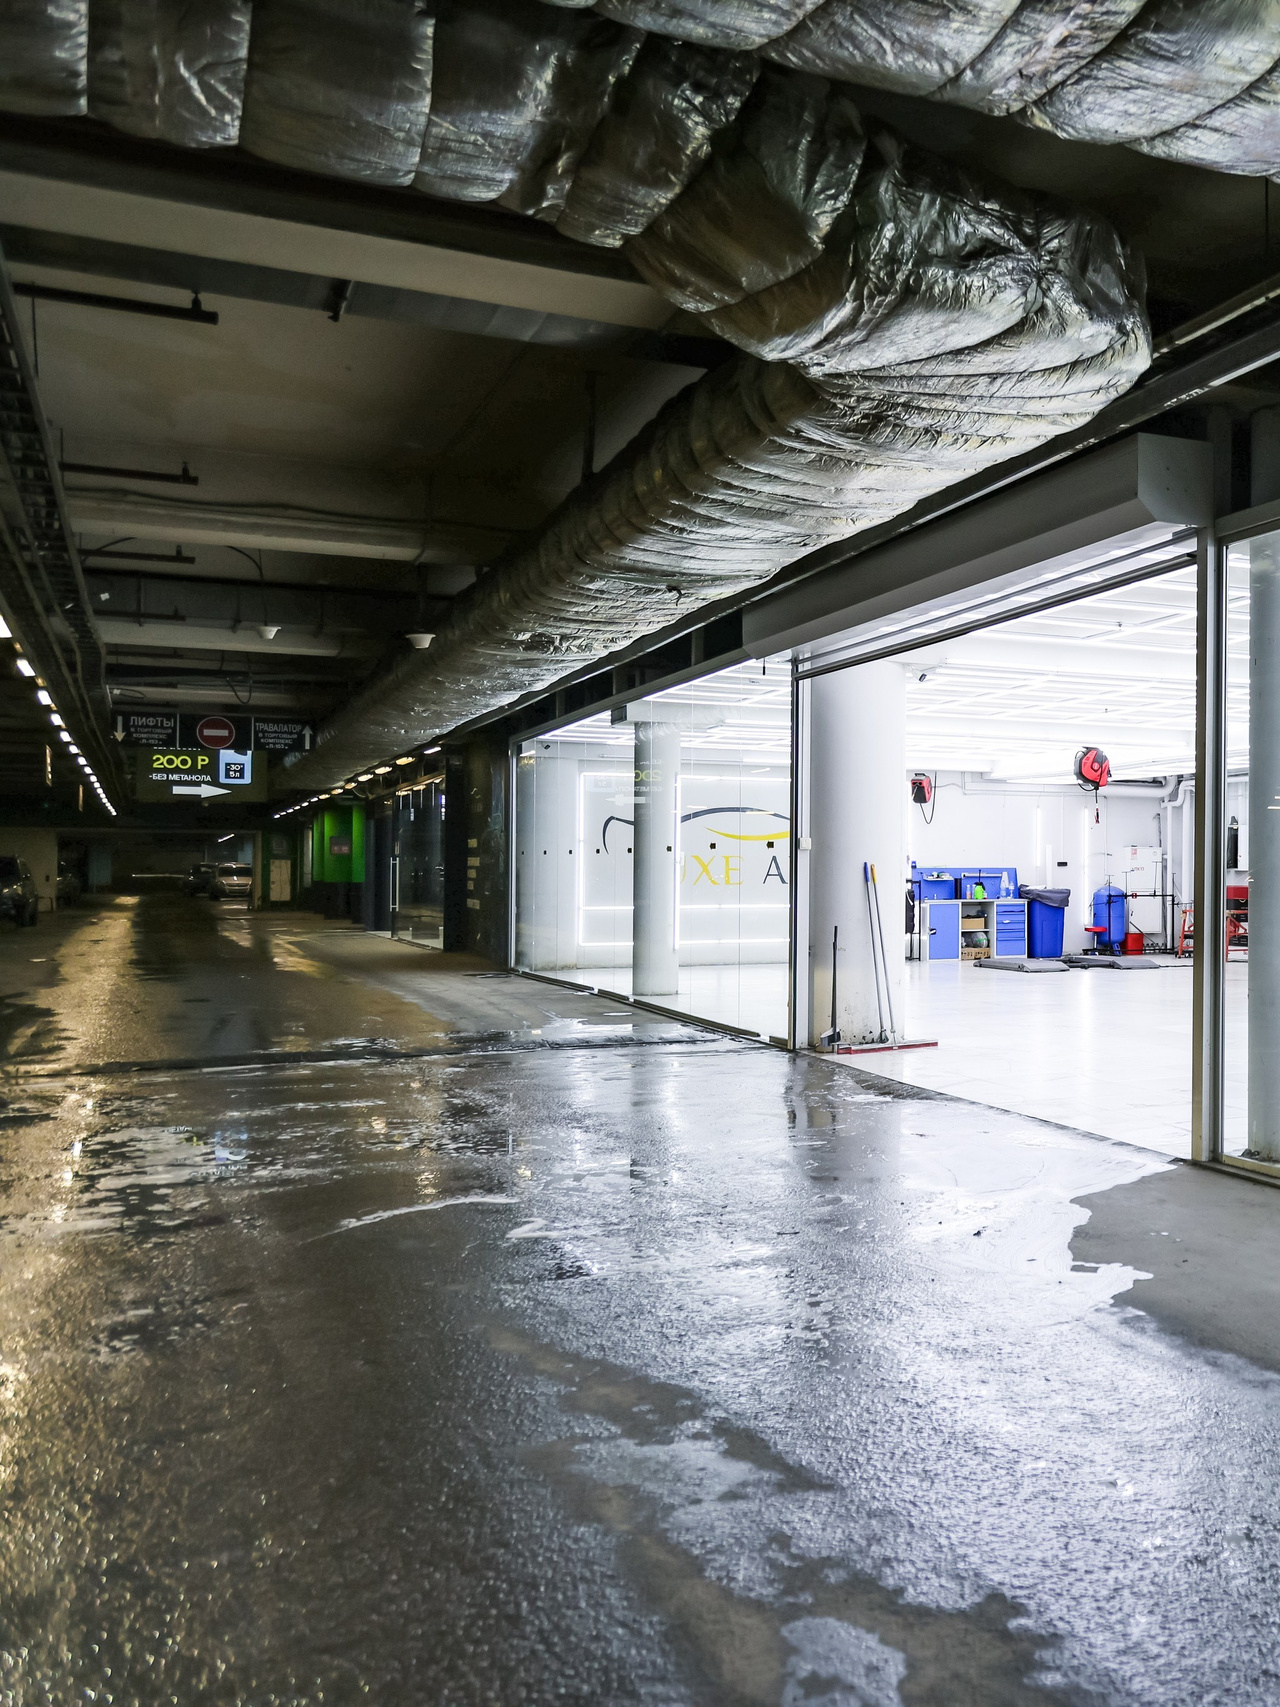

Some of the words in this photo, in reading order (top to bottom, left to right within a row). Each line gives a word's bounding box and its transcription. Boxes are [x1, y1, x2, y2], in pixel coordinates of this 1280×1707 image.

[130, 716, 174, 727] ЛИФТЫ
[255, 722, 302, 733] ТРАВАЛАТОР
[152, 754, 193, 770] 200
[168, 773, 212, 782] МЕТАНОЛА
[680, 854, 745, 886] XE
